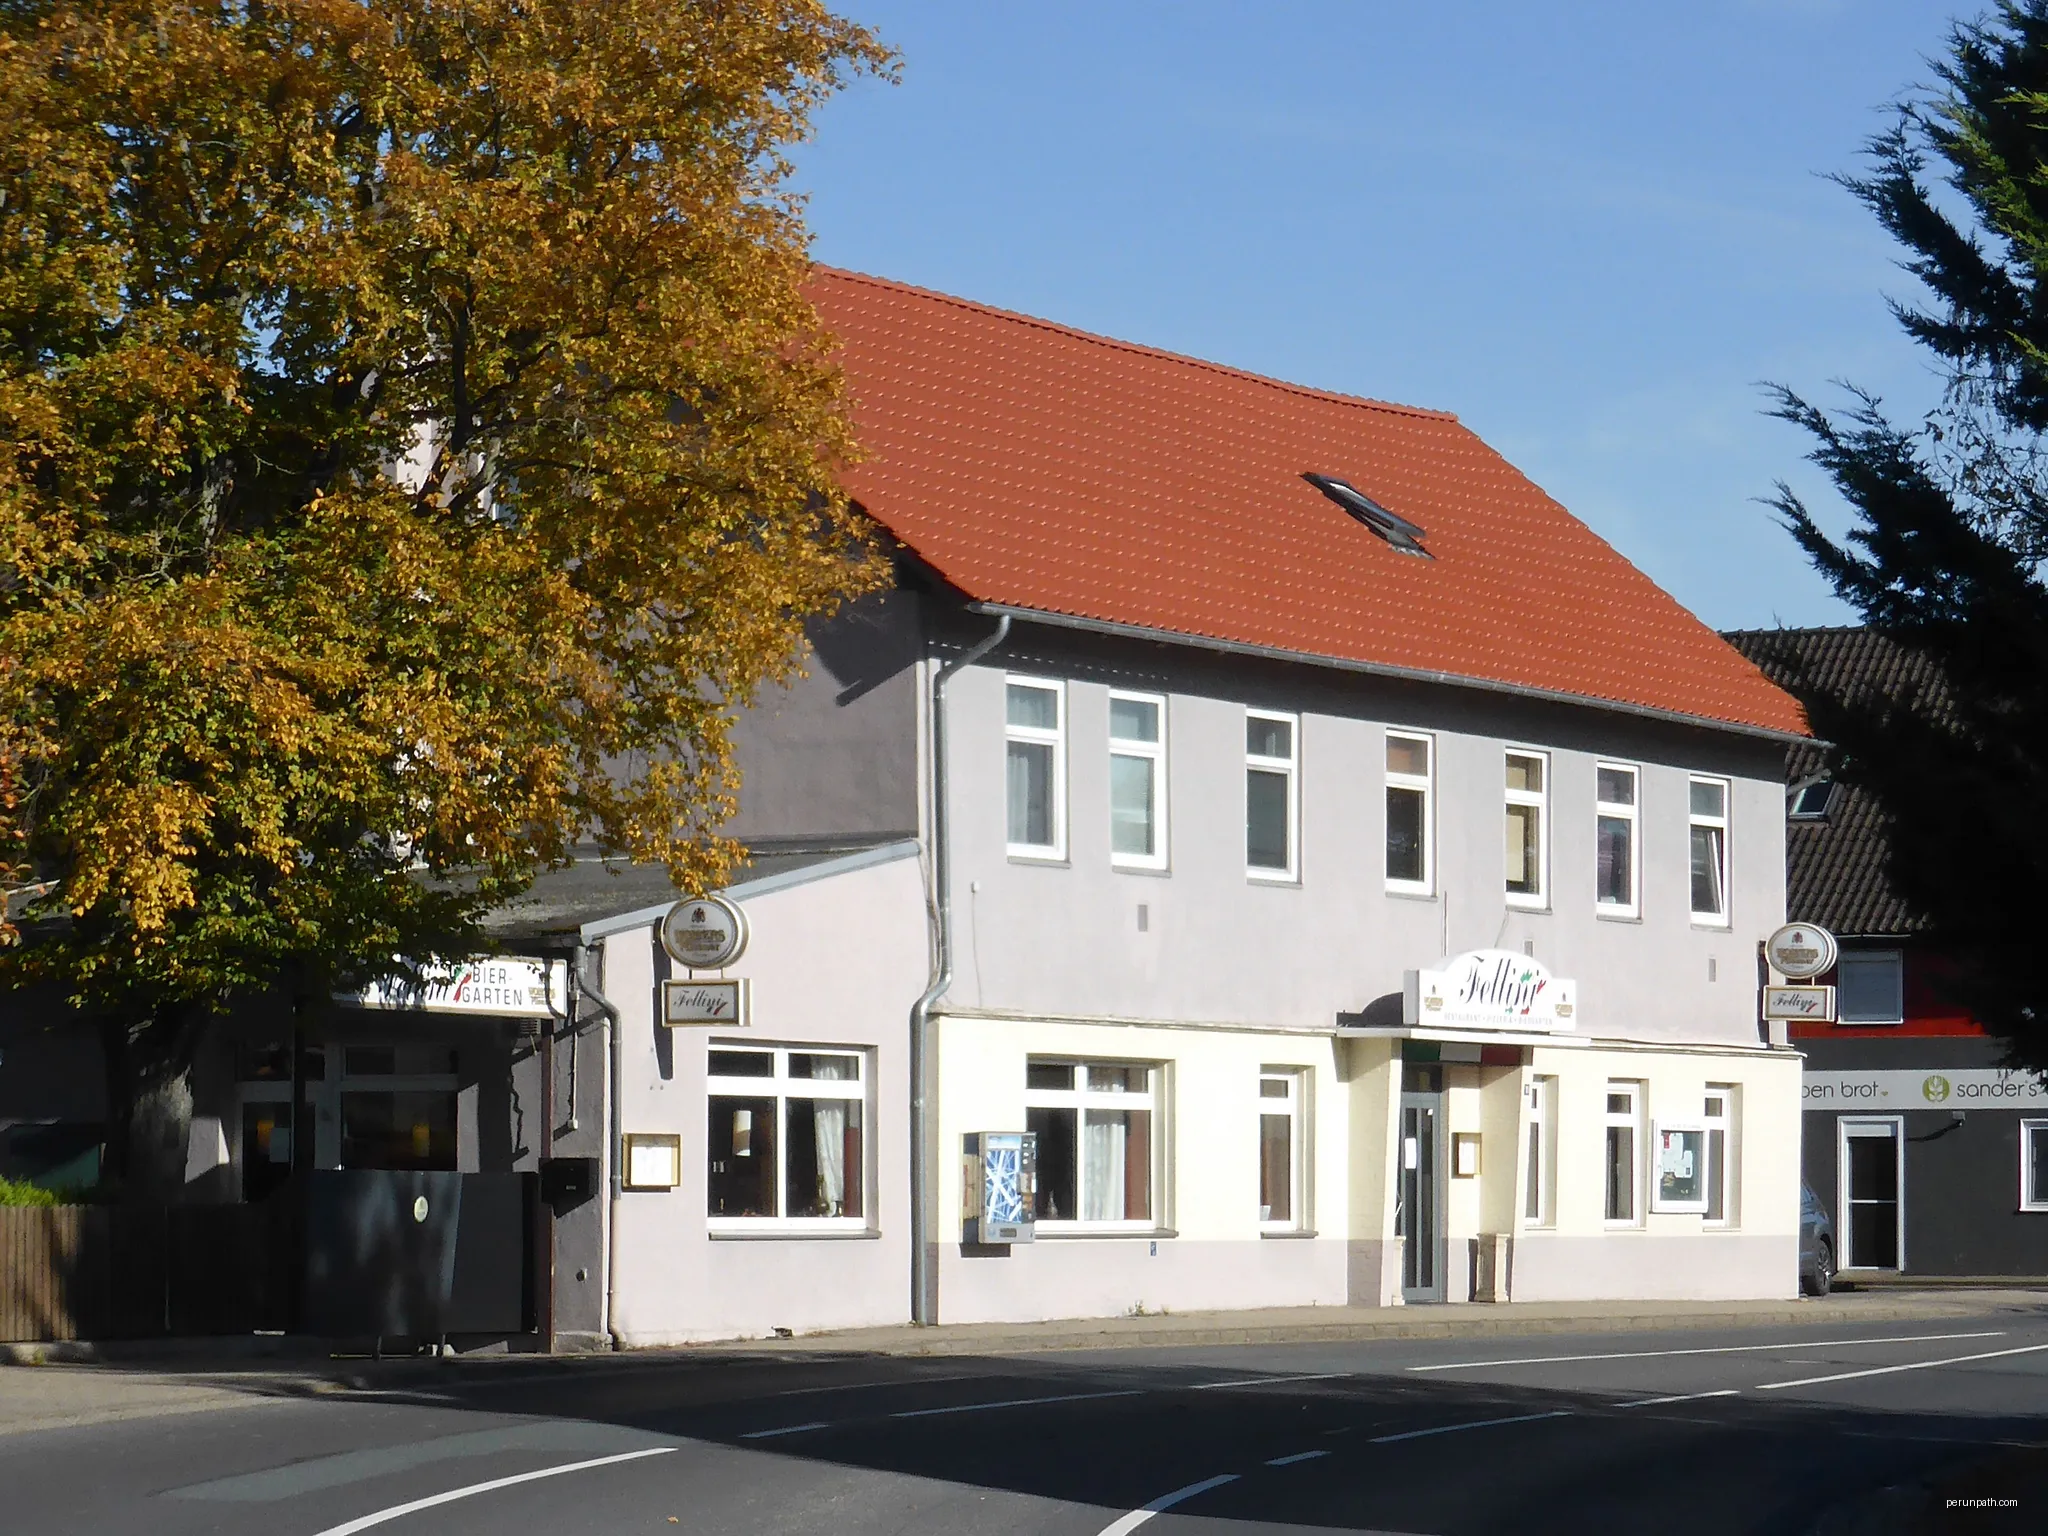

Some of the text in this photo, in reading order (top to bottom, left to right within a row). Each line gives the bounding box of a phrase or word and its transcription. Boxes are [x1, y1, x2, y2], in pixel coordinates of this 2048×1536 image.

[1459, 955, 1541, 1006] Fellini
[462, 987, 523, 1006] GARTEN
[673, 989, 724, 1009] Fellini
[1772, 992, 1815, 1007] Fellini
[1840, 1080, 1879, 1099] brot
[1957, 1079, 2038, 1098] sander's
